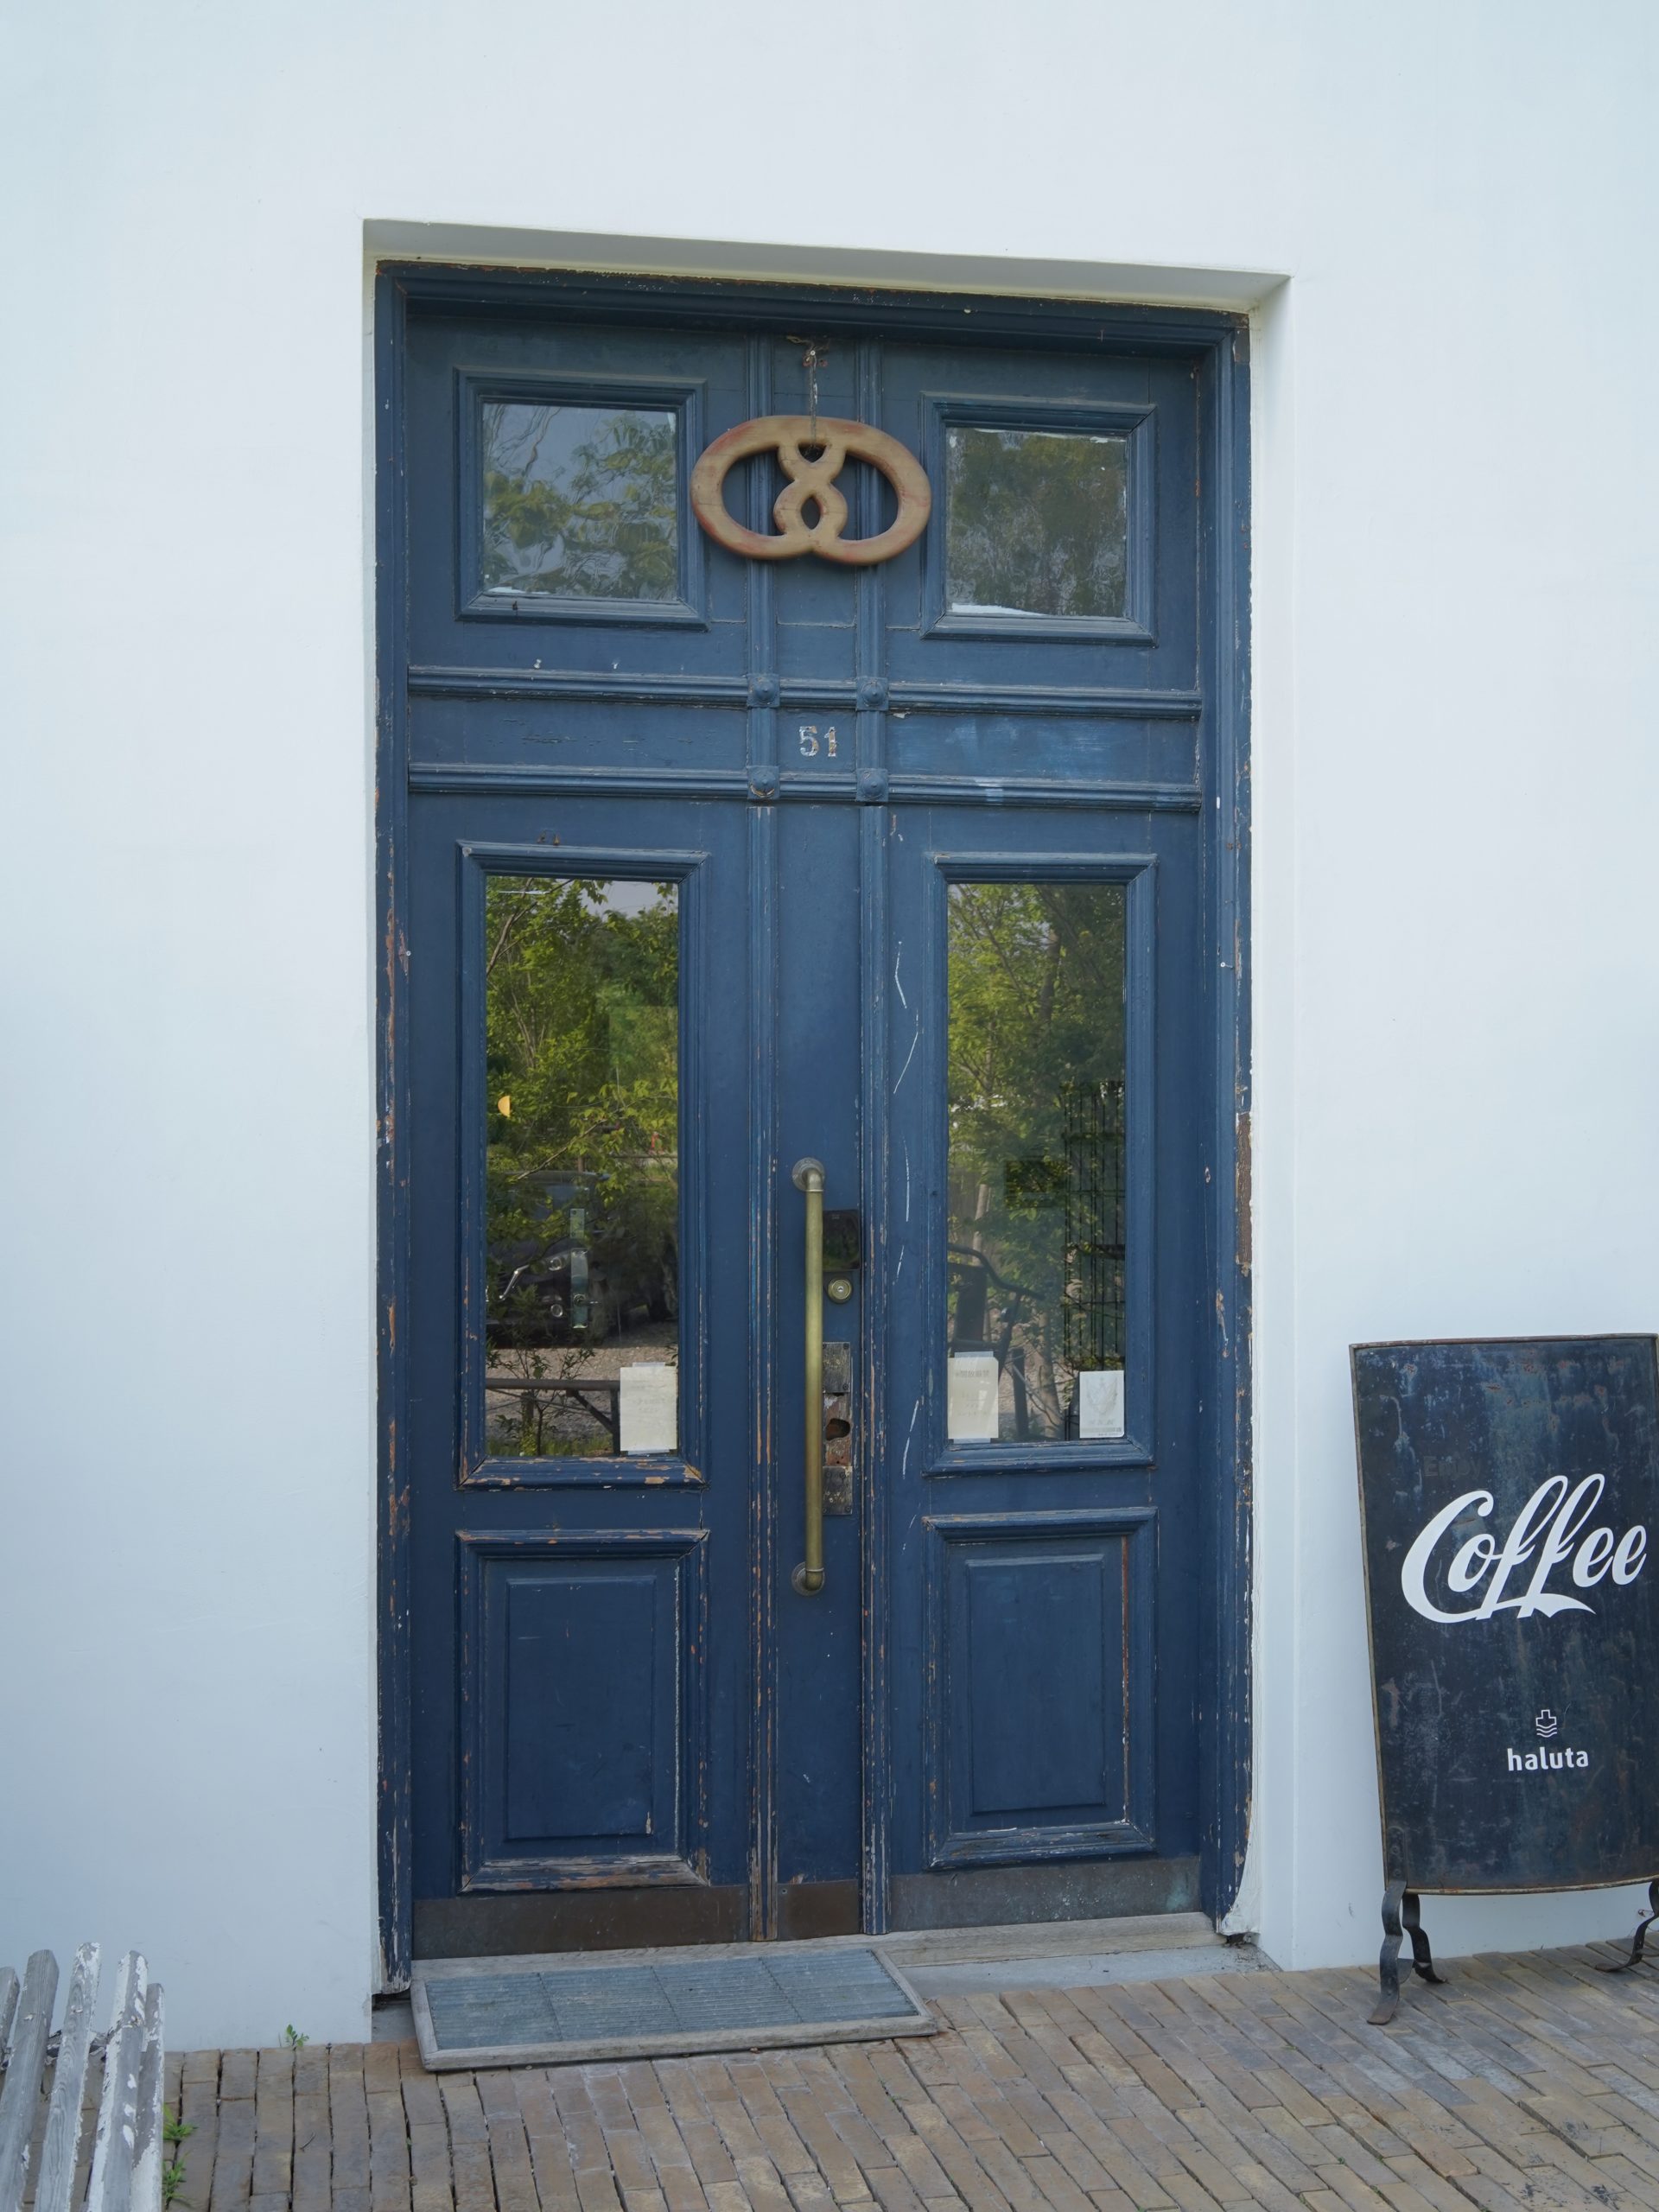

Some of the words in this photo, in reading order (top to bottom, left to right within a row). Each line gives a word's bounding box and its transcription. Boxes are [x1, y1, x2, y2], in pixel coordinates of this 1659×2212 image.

[799, 726, 837, 757] 51
[1402, 1473, 1646, 1624] Coffee
[1507, 1746, 1589, 1771] haluta
